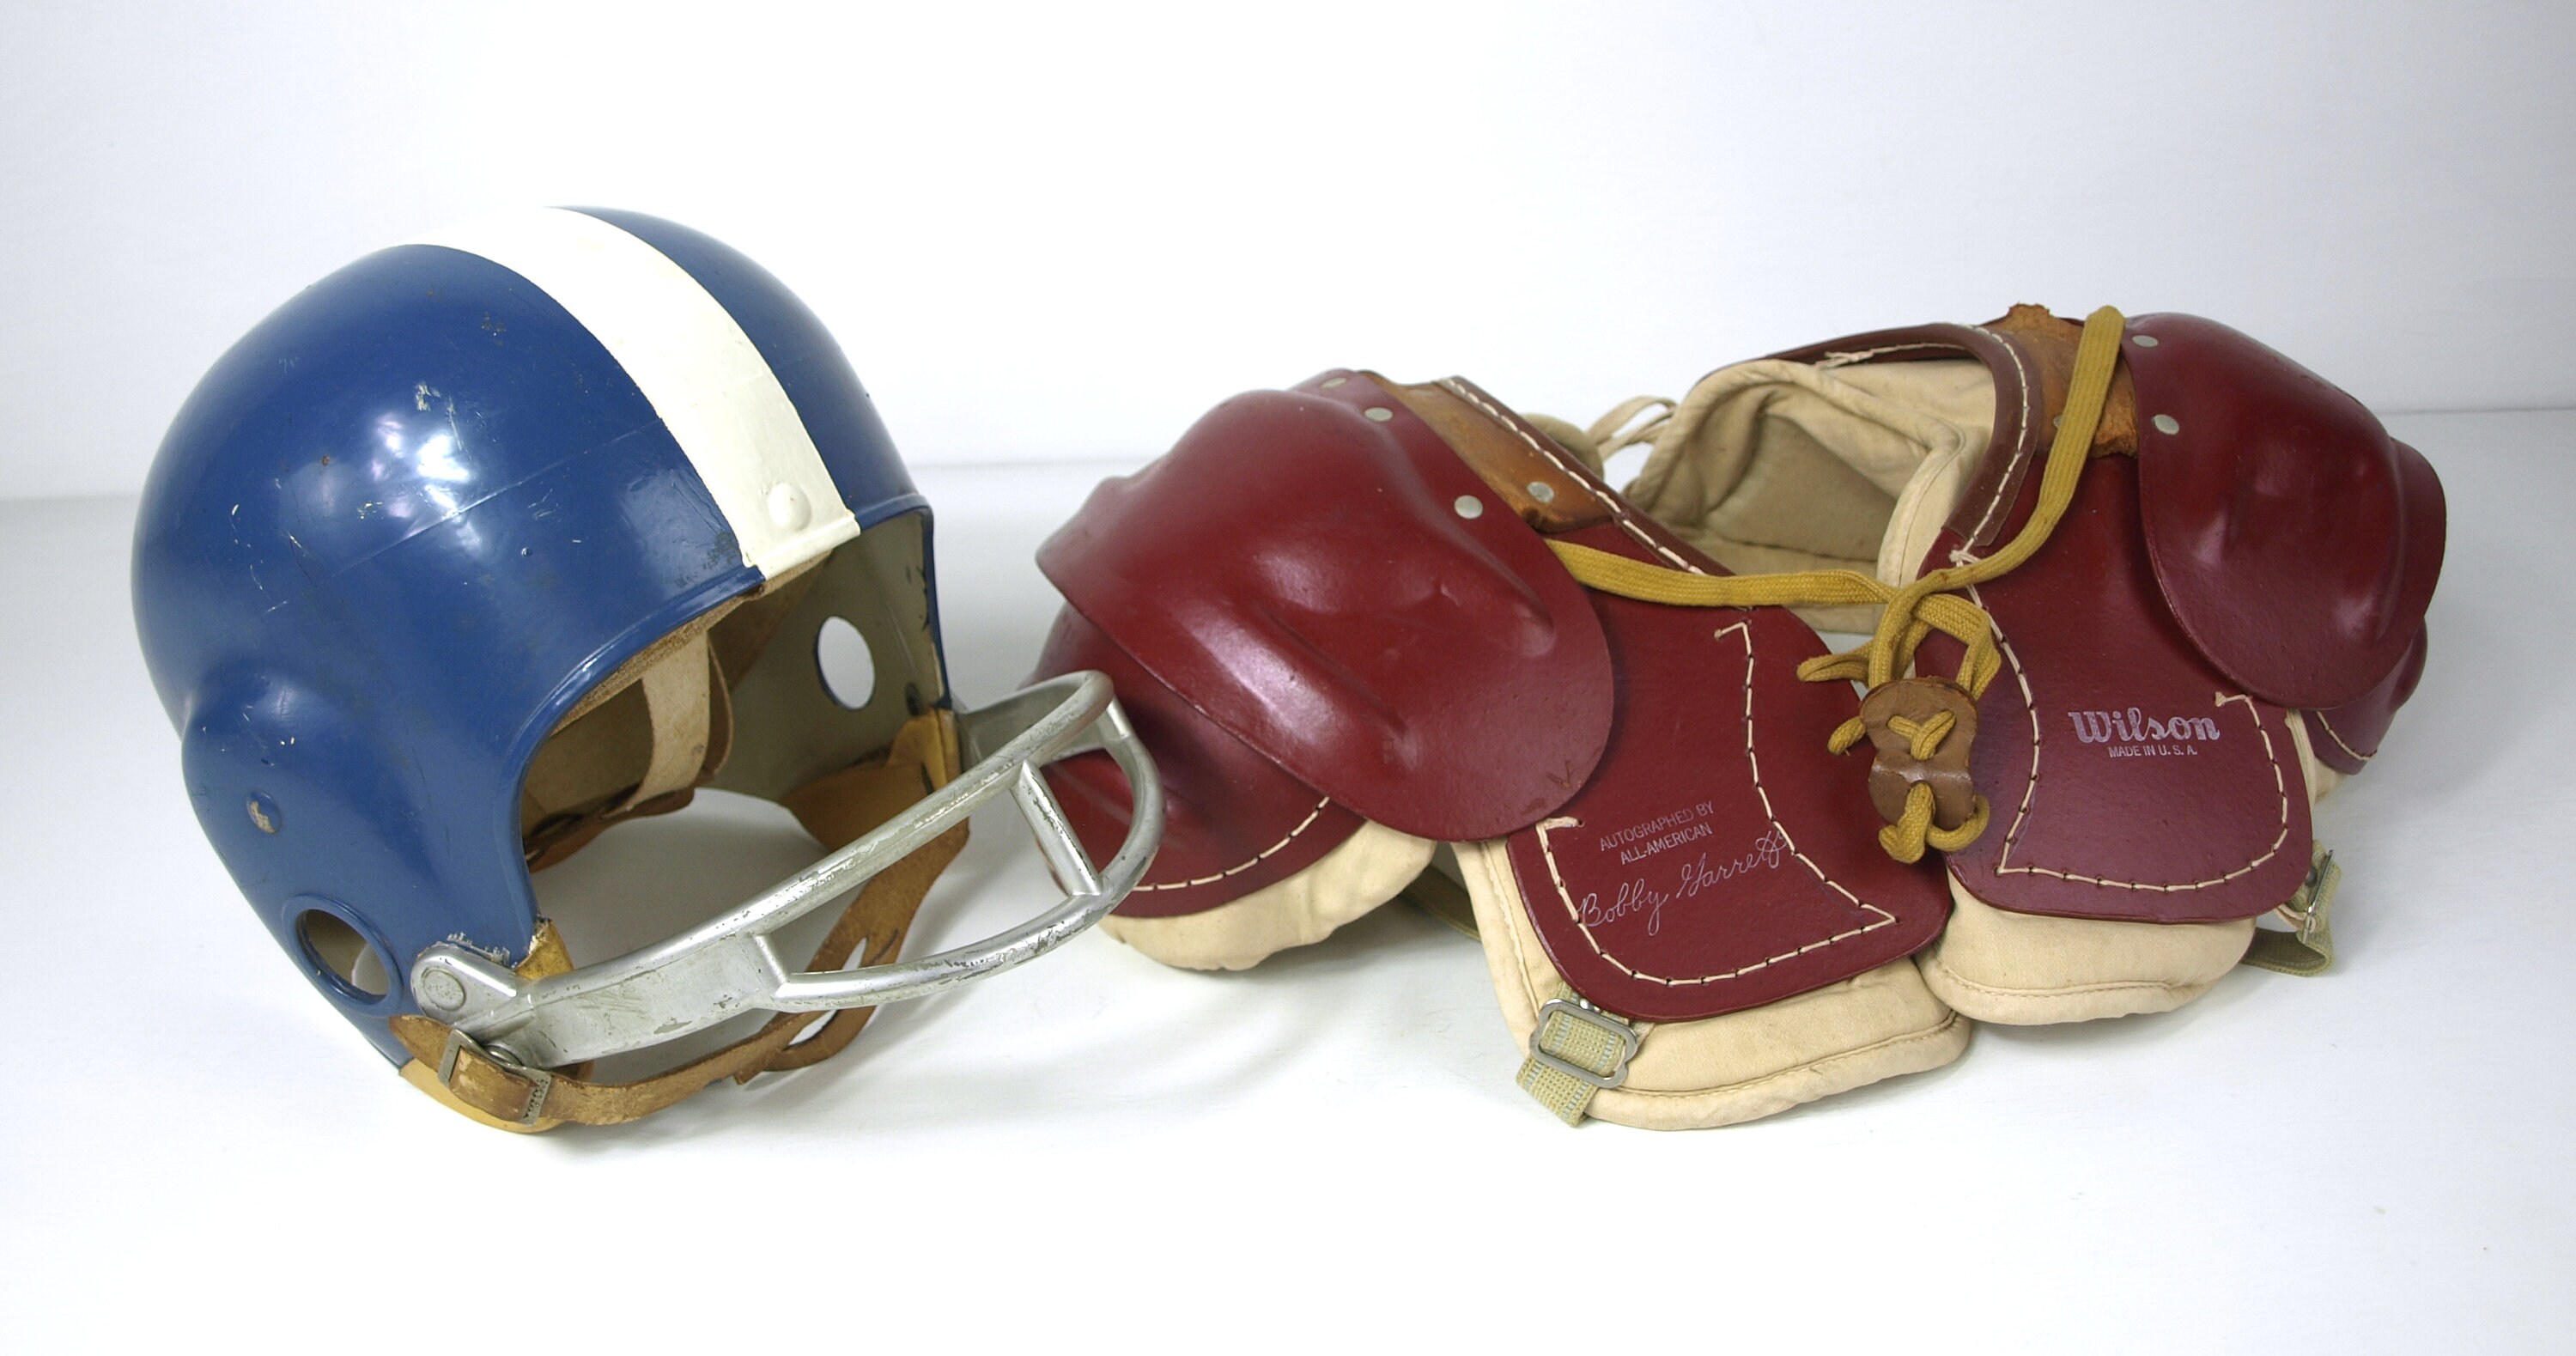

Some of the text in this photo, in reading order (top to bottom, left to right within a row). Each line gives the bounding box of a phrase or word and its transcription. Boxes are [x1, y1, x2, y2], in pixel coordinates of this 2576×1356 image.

[2068, 707, 2221, 743] Wilson
[2107, 745, 2142, 757] MADE
[2144, 745, 2156, 757] IN
[1600, 800, 1714, 851] AUTOGRAPHED BY
[1619, 822, 1713, 865] ALL-AMERICAN
[1577, 830, 1789, 936] Bobby Garrett
